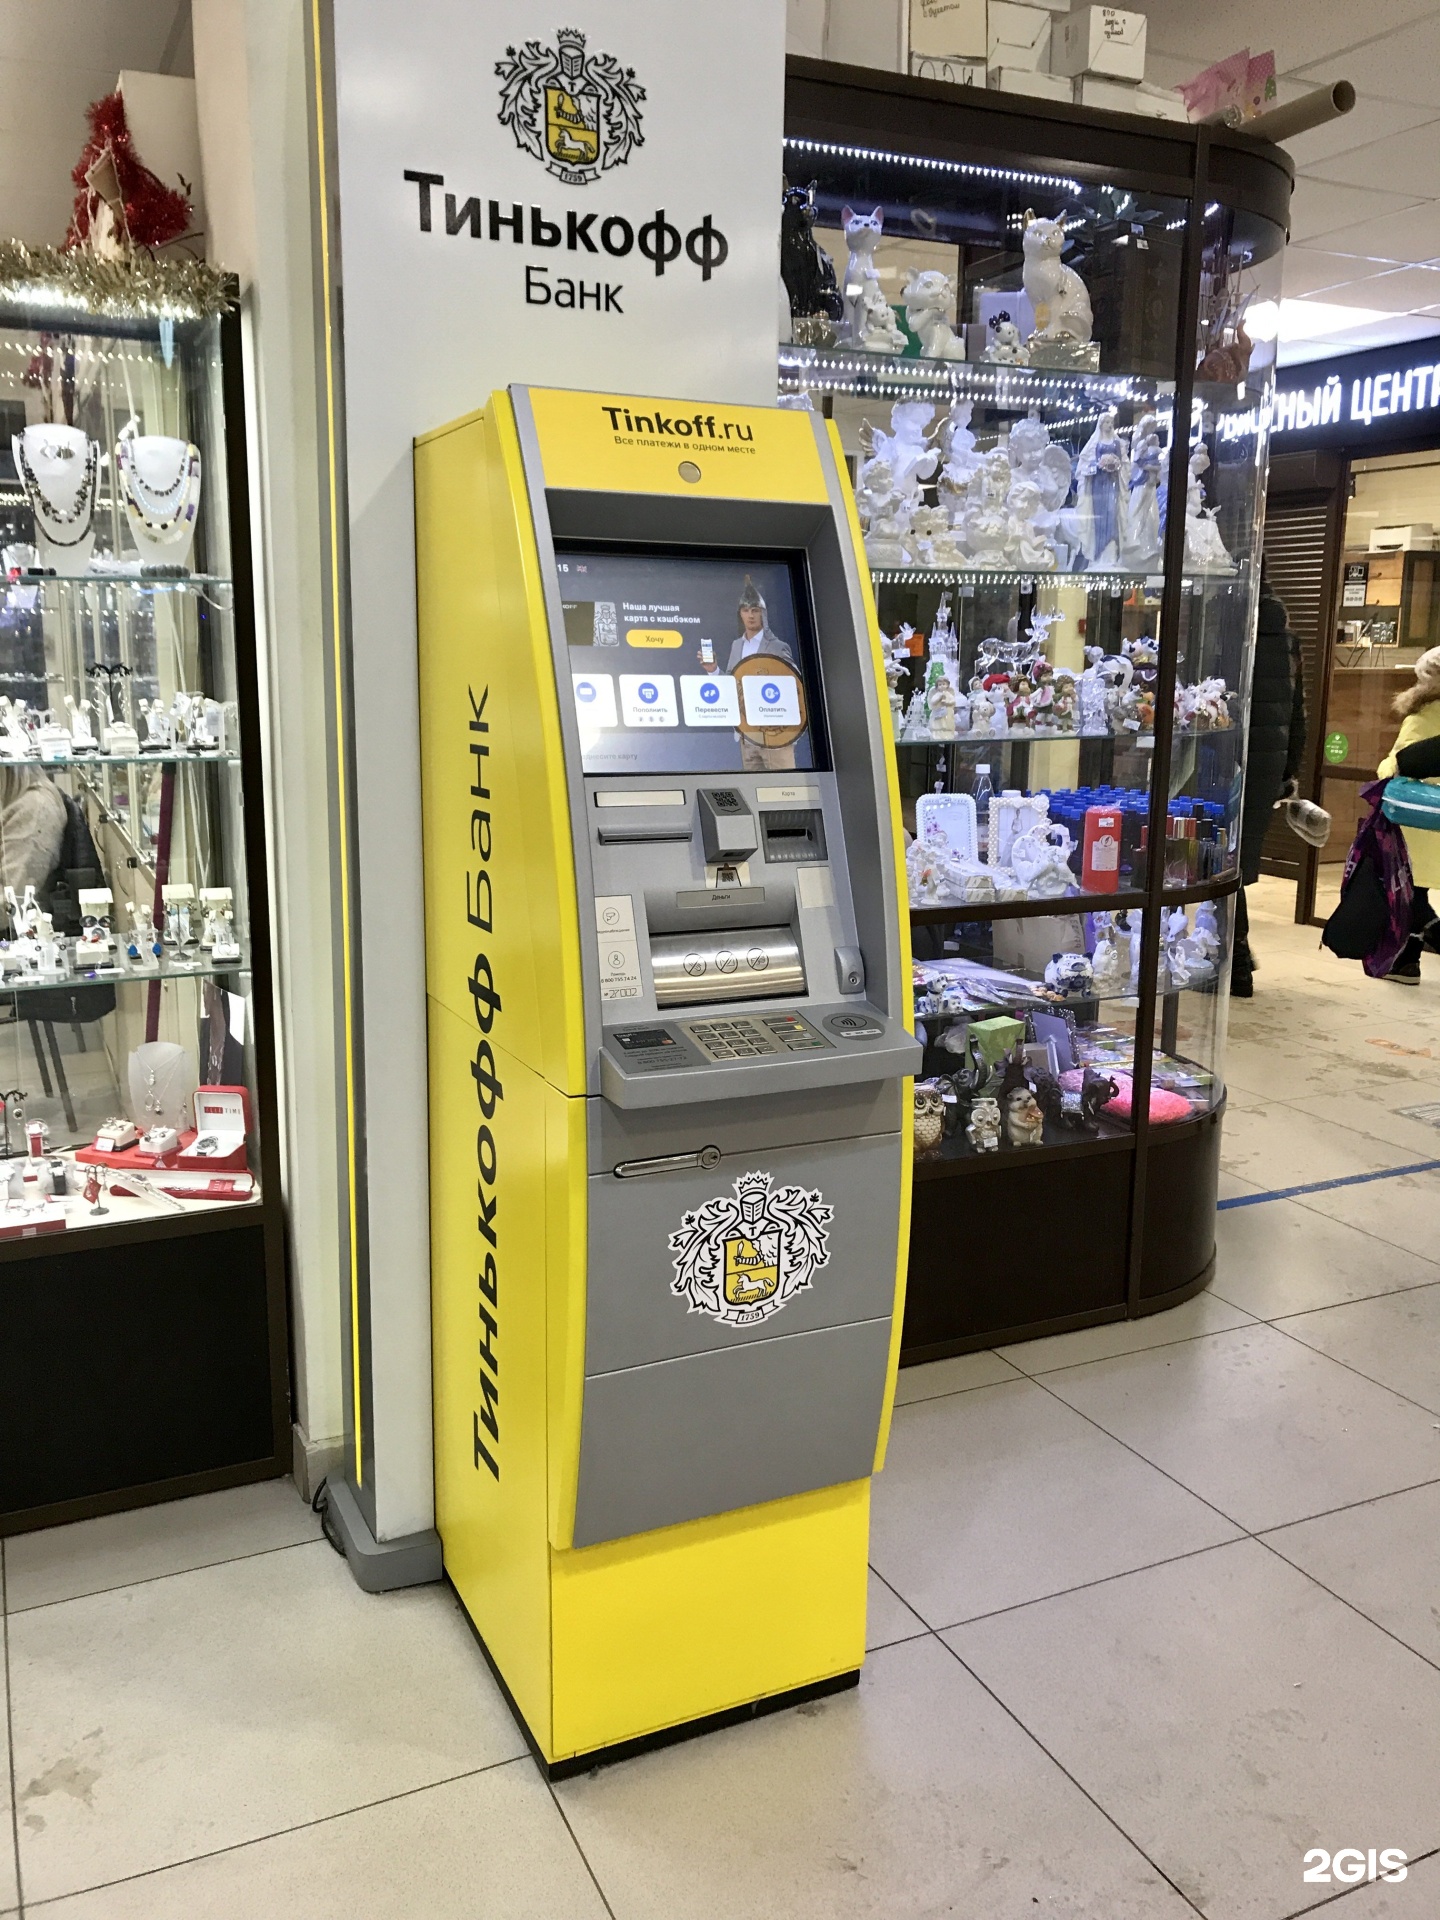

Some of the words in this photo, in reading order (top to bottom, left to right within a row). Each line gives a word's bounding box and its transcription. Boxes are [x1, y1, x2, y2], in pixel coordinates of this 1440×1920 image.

[403, 169, 729, 282] Тинькофф
[525, 265, 624, 313] Банк
[602, 406, 754, 442] Tinkoff.ru
[614, 436, 634, 446] Все
[636, 439, 682, 450] платежи
[684, 442, 690, 450] в
[692, 443, 725, 453] одном
[727, 446, 756, 455] месте
[622, 602, 647, 611] Наша
[648, 604, 680, 613] лучшая
[624, 615, 648, 624] карта
[657, 615, 701, 624] кэшбэком
[645, 635, 664, 644] Хочу
[466, 684, 493, 935] Банк
[467, 953, 504, 1483] Тинькофф
[740, 1311, 760, 1321] 1759
